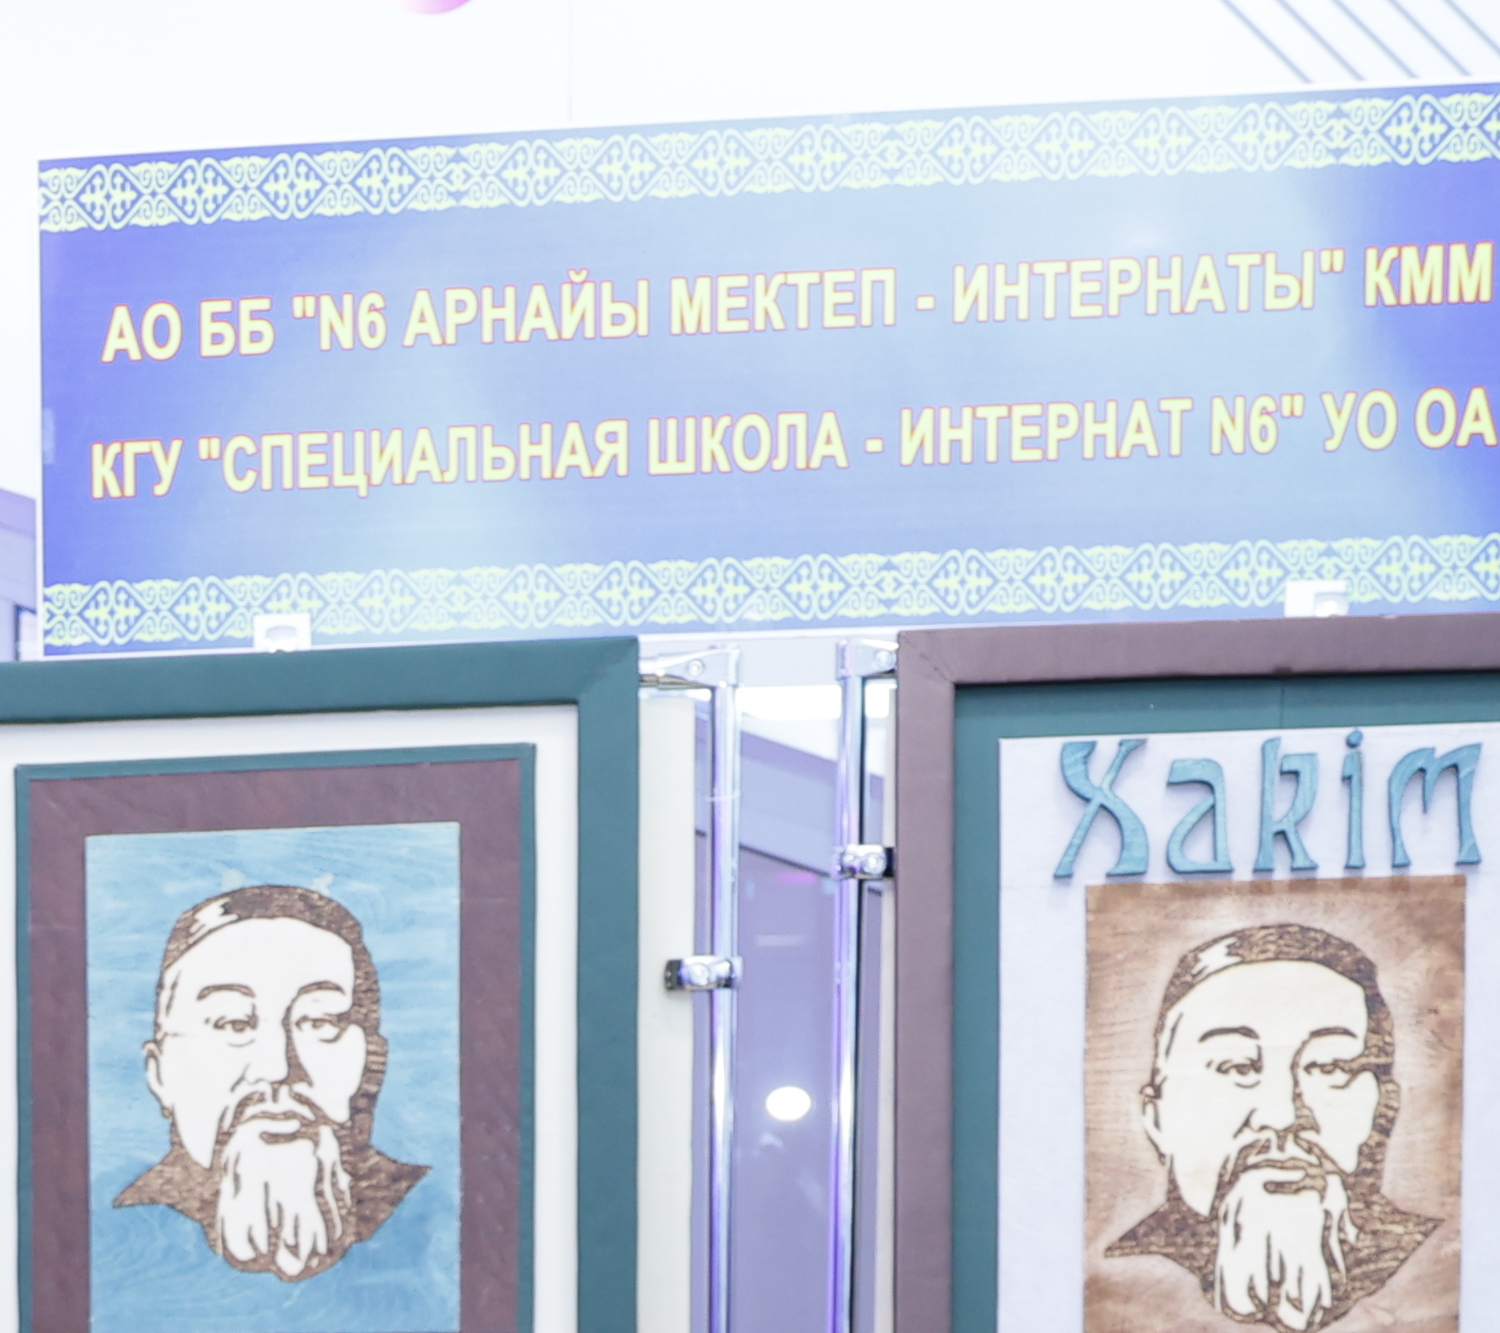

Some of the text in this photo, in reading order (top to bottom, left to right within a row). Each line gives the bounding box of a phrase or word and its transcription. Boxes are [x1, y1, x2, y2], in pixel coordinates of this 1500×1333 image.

[101, 241, 1494, 362] АО ББ "N6 АРНАЙЫ МЕКТЕП - ИНТЕРНАТЫ" КММ
[90, 386, 1499, 499] КГУ "СПЕЦИАЛЬНАЯ ШКОЛА - ИНТЕРНАТ N6" УО ОА
